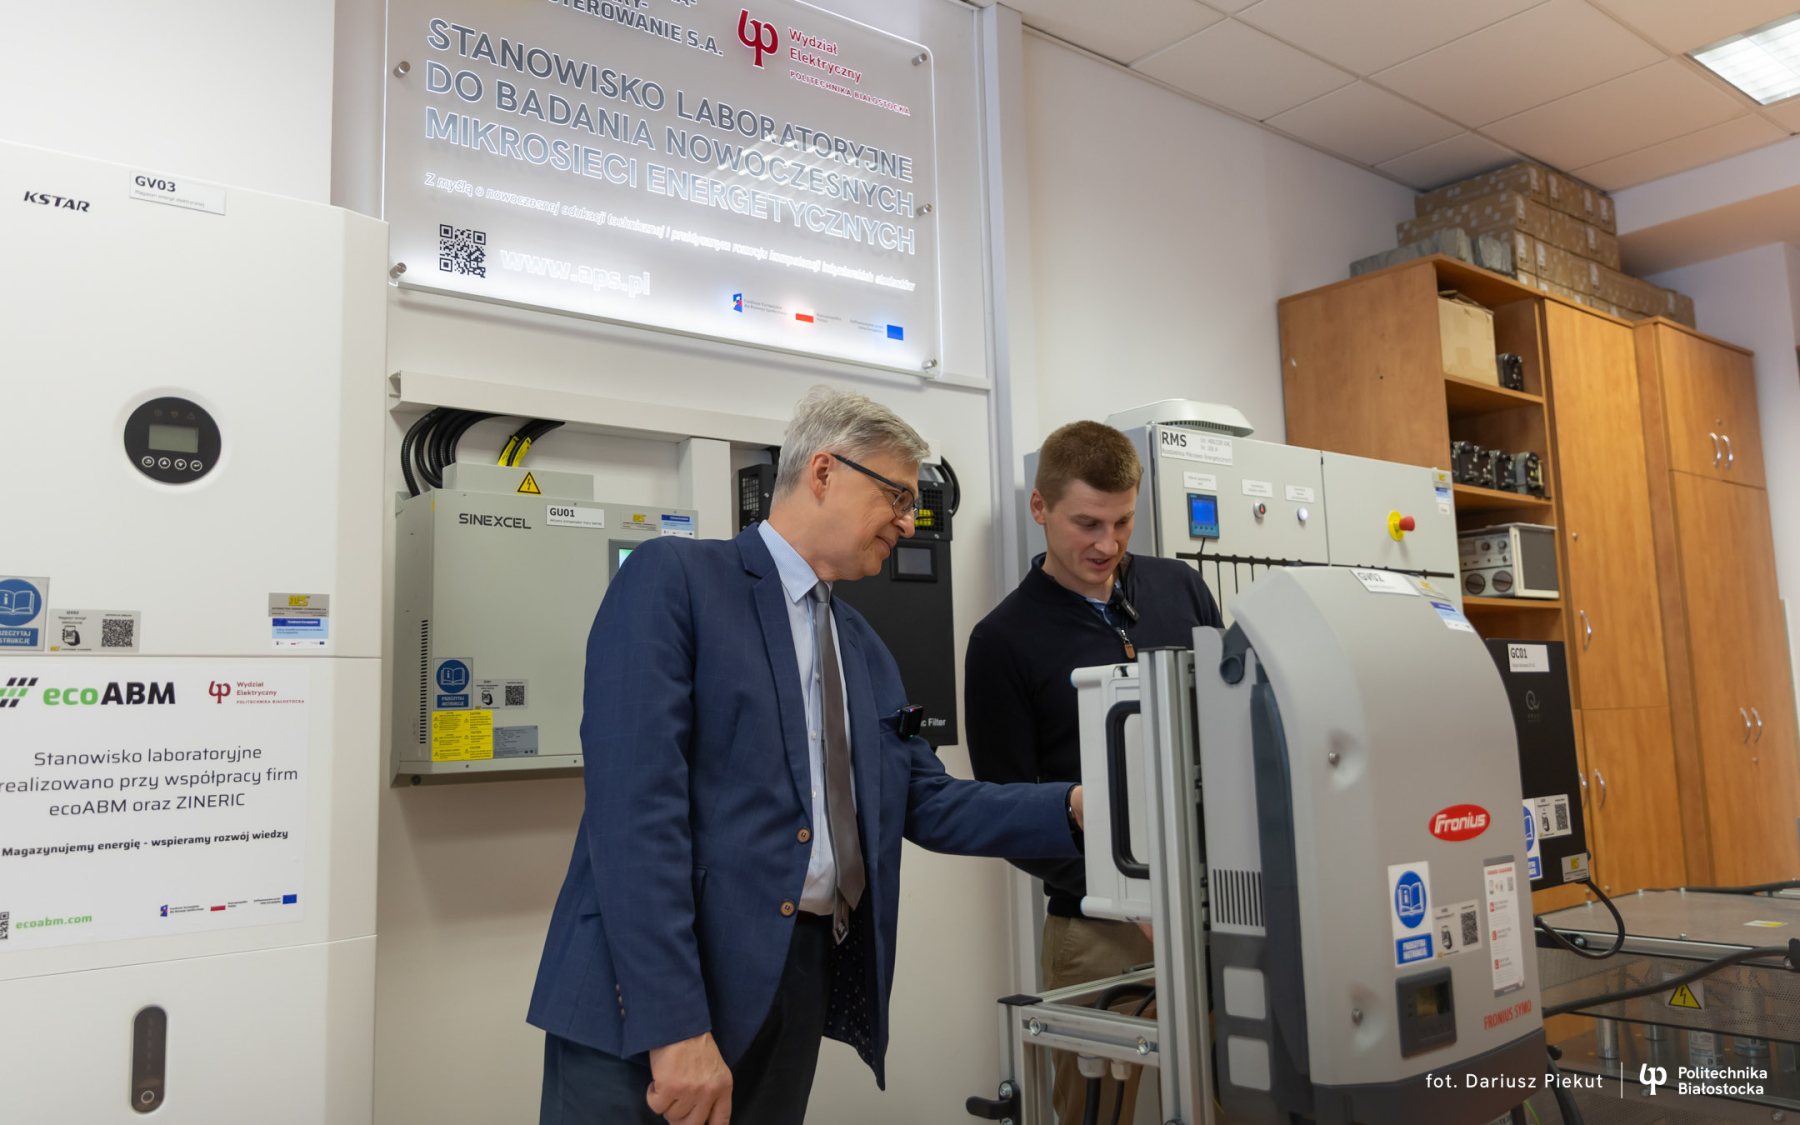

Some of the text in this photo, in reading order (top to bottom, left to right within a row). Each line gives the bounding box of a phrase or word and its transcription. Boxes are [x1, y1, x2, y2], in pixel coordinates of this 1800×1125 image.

[548, 0, 724, 56] EROWANIE S.A.
[788, 26, 838, 56] Wydział
[789, 46, 862, 84] Elektryczny
[789, 69, 853, 98] POLITECHNIKA
[427, 17, 914, 184] STANOWISKO LABORATORYJNE
[425, 60, 915, 218] DO BADANIA NOWOCZESNYCH
[135, 175, 177, 193] GV03
[424, 172, 436, 187] Z
[437, 177, 474, 197] myślą
[475, 186, 485, 197] o
[425, 106, 916, 255] MIKROSIECI ENERGETYCZNYCH
[23, 190, 91, 212] KSTAR
[499, 249, 651, 298] www.aps.pl
[1161, 431, 1187, 448] RMS
[458, 512, 532, 530] SINEXCEL
[549, 507, 575, 518] GU01
[43, 681, 176, 706] ecoABM
[928, 718, 946, 727] Filter
[34, 745, 262, 766] Stanowisko laboratoryjne
[0, 767, 299, 793] realizowano przy współpracy firm
[49, 793, 246, 816] ecoABM oraz ZINERIC
[1434, 813, 1487, 835] Fronius
[1, 842, 95, 858] Magazynujemy
[97, 838, 141, 851] energię
[151, 834, 212, 848] wspieramy
[214, 830, 250, 843] rozwój
[252, 829, 289, 842] wiedzy
[15, 913, 93, 930] ecoabm.com
[1484, 1007, 1514, 1031] FRONIUS
